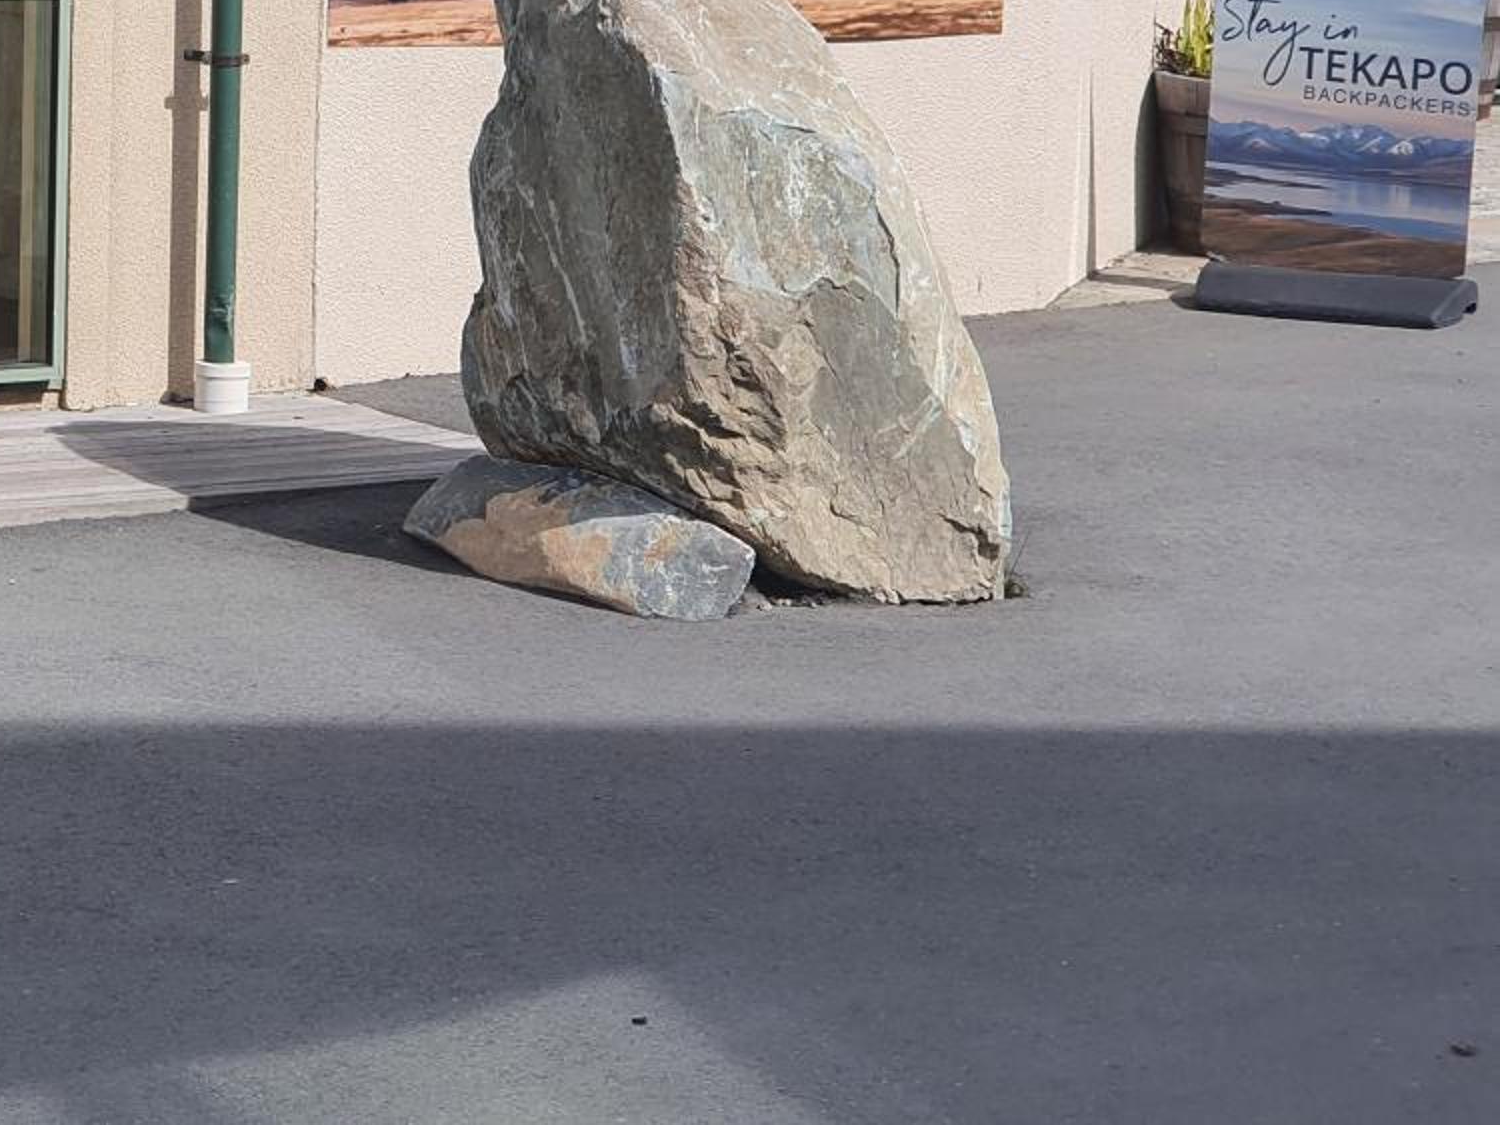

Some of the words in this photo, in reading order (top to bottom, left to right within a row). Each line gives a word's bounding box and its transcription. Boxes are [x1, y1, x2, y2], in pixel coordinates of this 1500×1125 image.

[1323, 14, 1357, 40] in
[1300, 46, 1473, 95] TEKAPO
[1303, 84, 1470, 118] BACKPACKERS
